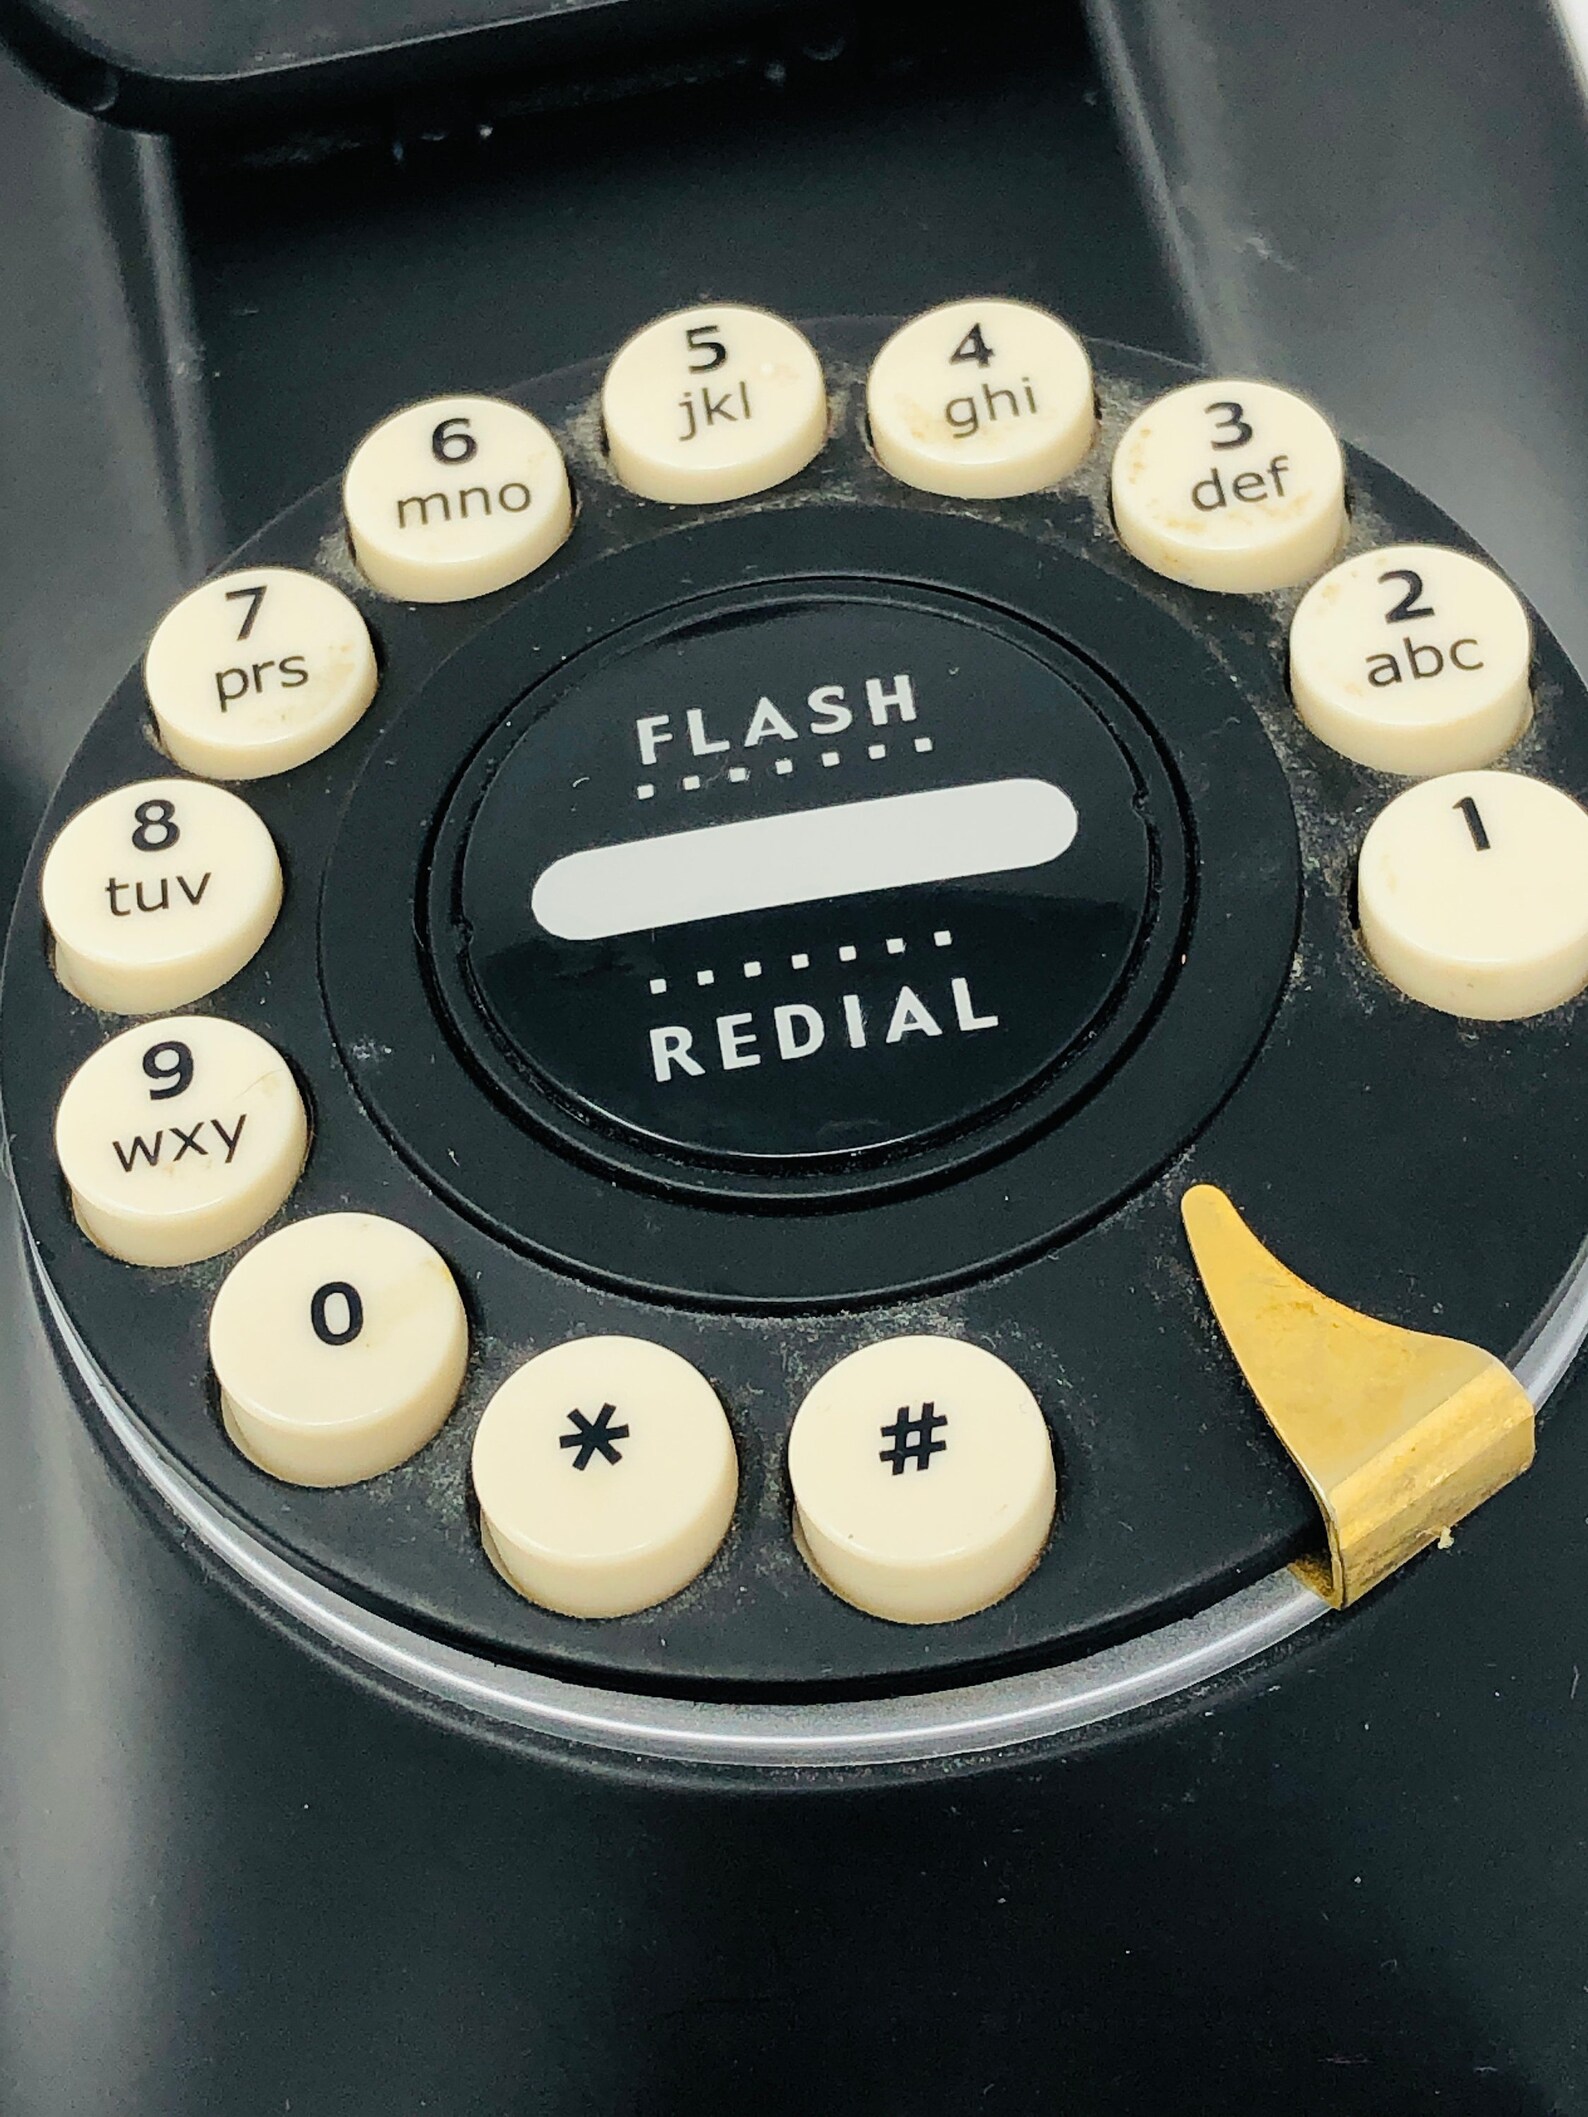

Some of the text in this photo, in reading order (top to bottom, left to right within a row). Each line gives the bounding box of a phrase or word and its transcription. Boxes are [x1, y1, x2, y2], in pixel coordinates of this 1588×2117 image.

[685, 324, 727, 372] 5
[950, 322, 994, 367] 4
[679, 382, 750, 441] jkl
[944, 378, 1037, 436] ghi
[1205, 401, 1254, 449] 3
[431, 417, 478, 465] 6
[397, 481, 532, 528] mno
[1191, 455, 1290, 511] def
[225, 585, 268, 641] 7
[1379, 568, 1434, 624] 2
[214, 654, 310, 712] prs
[1366, 634, 1484, 687] abc
[636, 674, 918, 765] FLASH
[131, 798, 180, 852] 8
[1453, 796, 1491, 851] 1
[105, 871, 212, 917] tuv
[649, 977, 999, 1083] REDIAL
[142, 1039, 194, 1101] 9
[112, 1113, 247, 1173] wxy
[310, 1281, 364, 1347] 0
